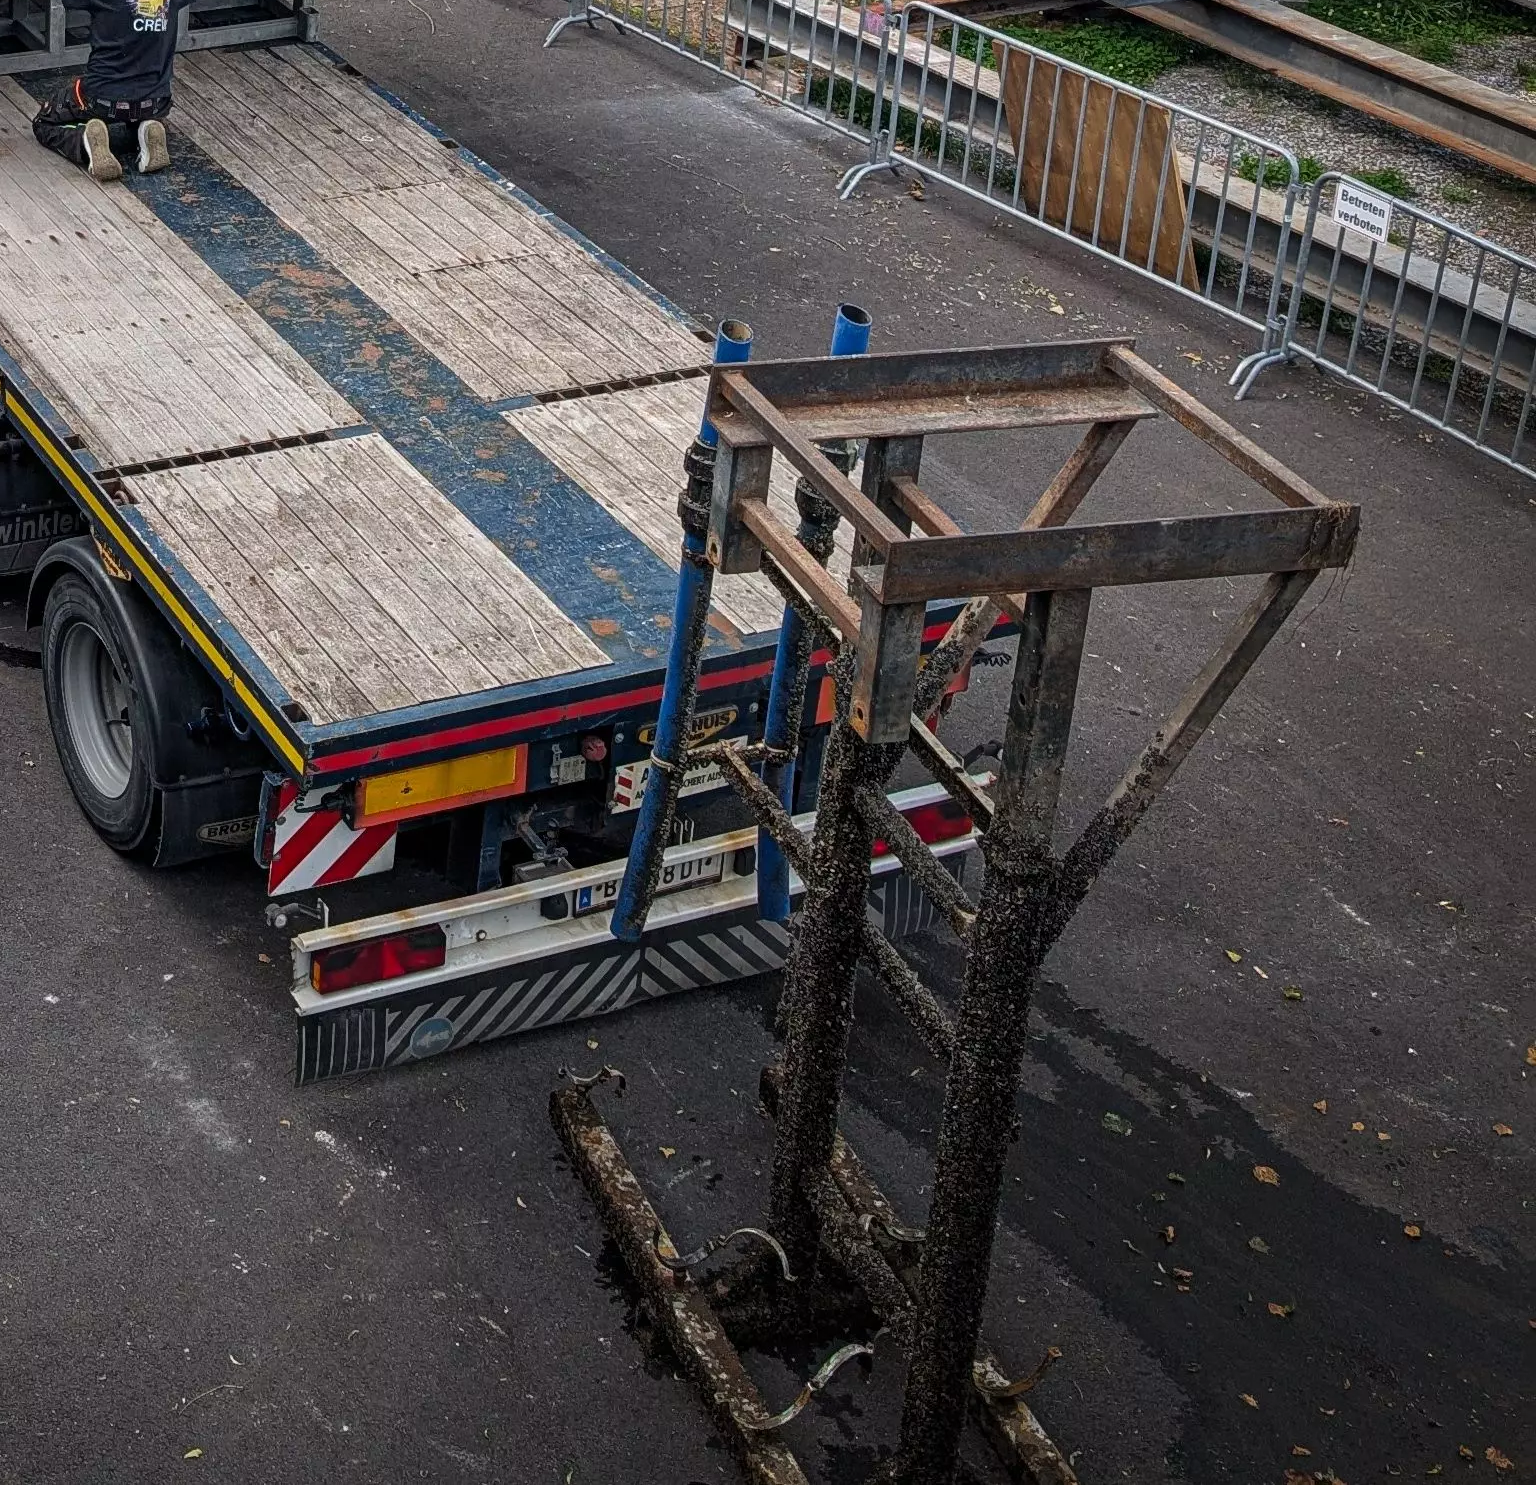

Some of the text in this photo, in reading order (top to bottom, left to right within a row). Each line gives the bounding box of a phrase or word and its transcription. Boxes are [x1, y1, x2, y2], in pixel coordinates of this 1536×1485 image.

[1341, 189, 1385, 218] Betreten
[1338, 209, 1383, 236] verboten
[683, 775, 706, 788] CHERT
